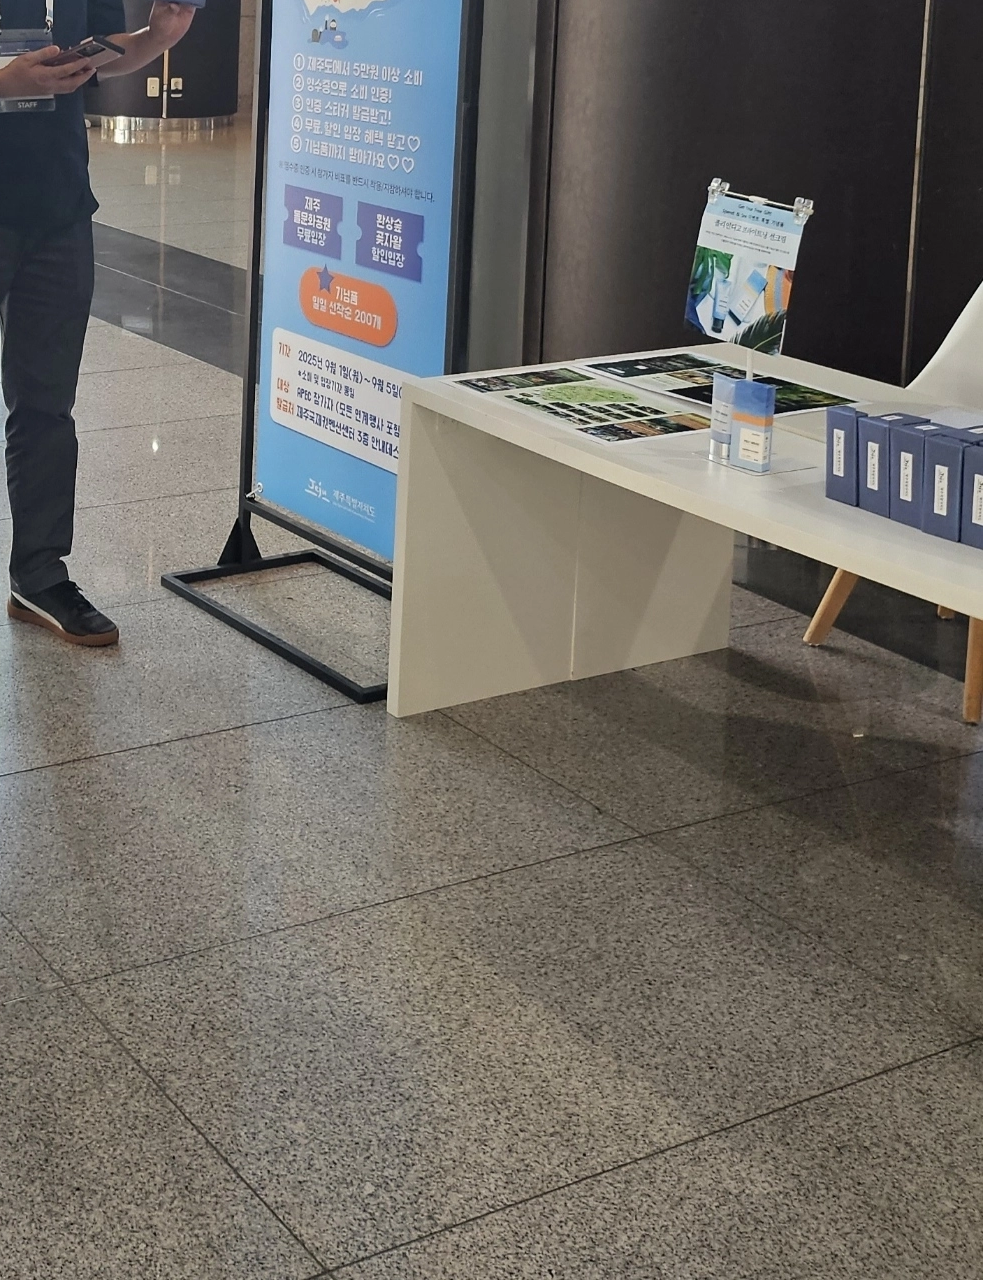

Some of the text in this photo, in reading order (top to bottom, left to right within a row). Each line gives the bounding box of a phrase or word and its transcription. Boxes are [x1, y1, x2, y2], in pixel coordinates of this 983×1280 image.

[307, 56, 350, 76] 제주도에서
[353, 62, 379, 80] 5만원
[382, 66, 400, 83] 이상
[404, 69, 423, 86] 소비
[306, 77, 347, 97] 영수증으로
[350, 84, 368, 99] 소비
[371, 87, 392, 103] 인증!
[17, 101, 37, 109] STAFF
[306, 98, 322, 114] 인증
[325, 102, 349, 119] 스티커
[352, 104, 392, 126] 발급받고!
[324, 122, 341, 139] 할인
[344, 125, 361, 142] 입장
[364, 129, 384, 146] 혜택
[387, 133, 405, 151] 받고
[305, 138, 346, 160] 기념품까지
[349, 147, 385, 169] 받아가요
[304, 196, 321, 212] 제주
[293, 209, 331, 232] 돌문화공원
[376, 213, 403, 233] 환상숲
[297, 227, 326, 247] 무료입장
[375, 231, 403, 250] 곶자왈
[371, 246, 405, 268] 할인입장
[335, 286, 359, 306] 기념품
[329, 301, 352, 321] 선착순
[355, 310, 382, 330] 200개
[278, 342, 291, 358] 기간
[298, 350, 323, 370] 2025년
[325, 359, 337, 375] 9월
[339, 364, 363, 384] 1일(월)
[372, 376, 384, 393] 9월
[277, 377, 290, 393] 대상
[297, 387, 312, 402] APEC
[313, 391, 334, 411] 참가자
[336, 401, 353, 419] (모든
[276, 397, 295, 415] 발급처
[296, 405, 355, 441] 제주국제컨벤션센터
[357, 430, 369, 446] 3층
